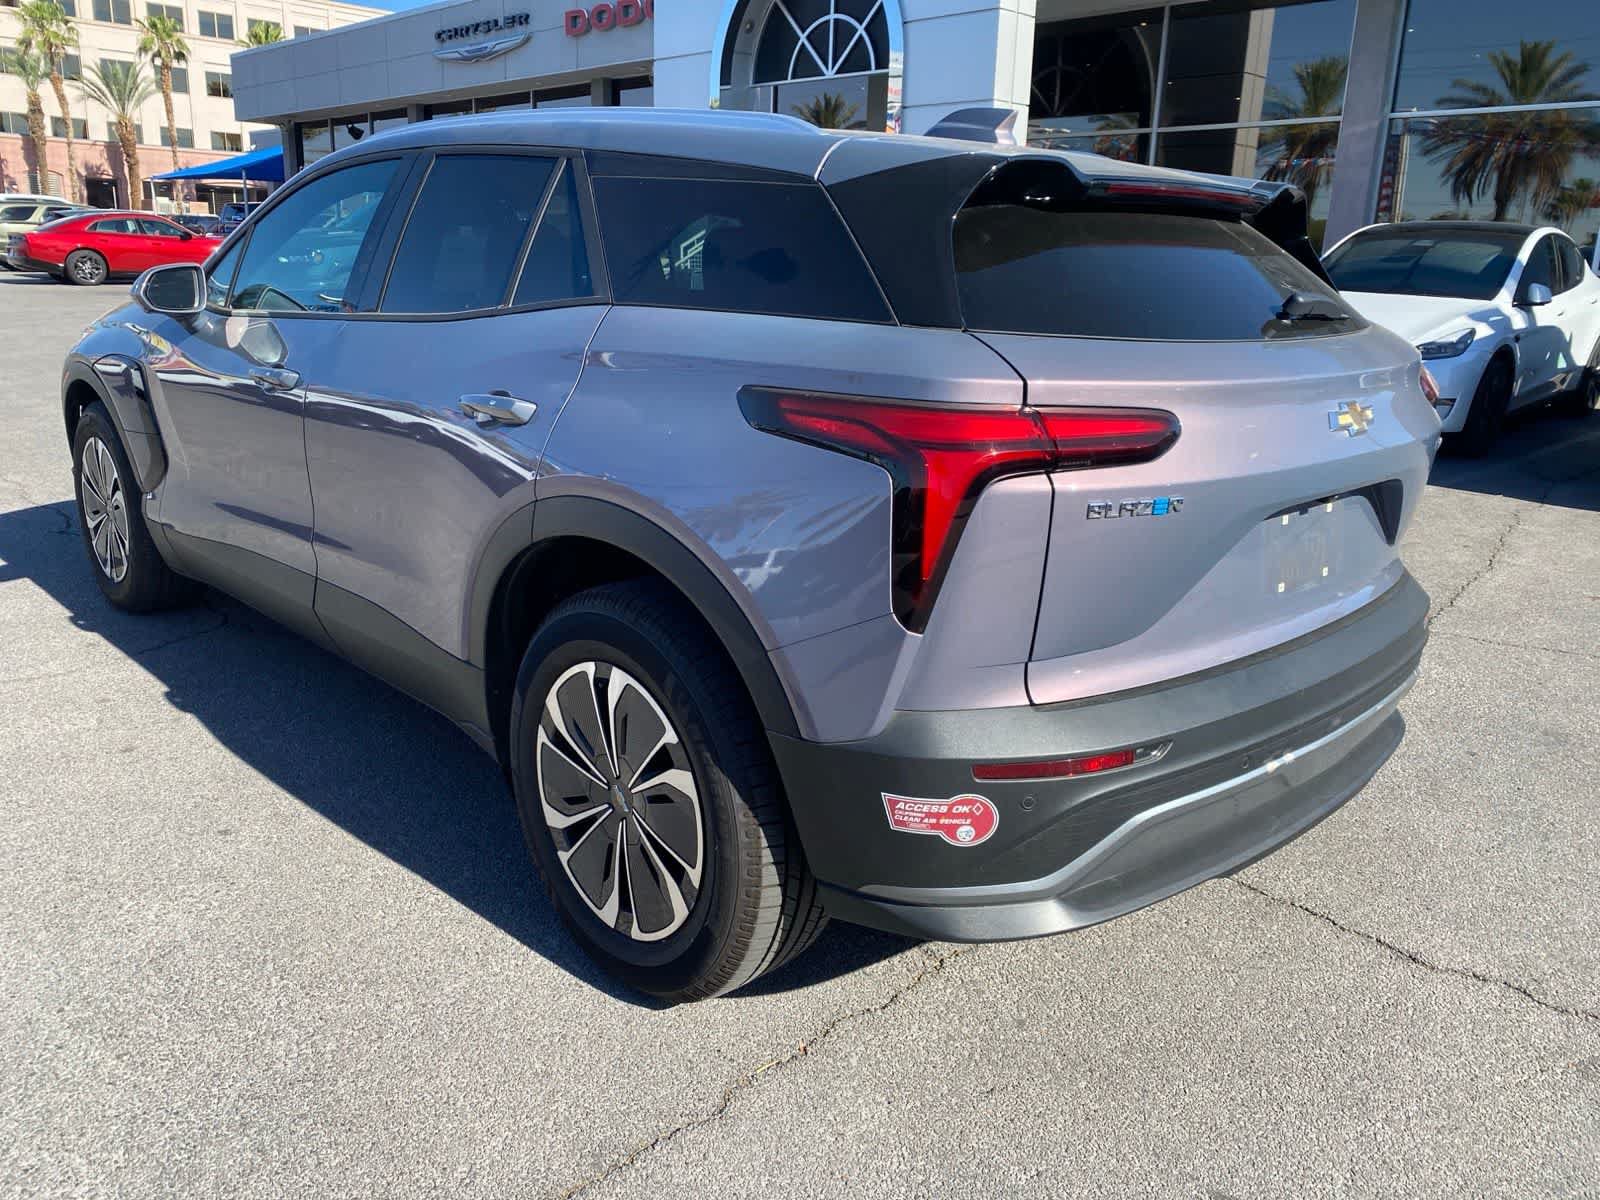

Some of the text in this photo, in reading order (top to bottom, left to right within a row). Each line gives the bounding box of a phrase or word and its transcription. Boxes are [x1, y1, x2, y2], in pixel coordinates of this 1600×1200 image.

[435, 13, 530, 42] CHRYSLER
[1086, 495, 1184, 520] BLAZER
[895, 802, 972, 814] ACCESS OK
[895, 814, 921, 823] CLEAN
